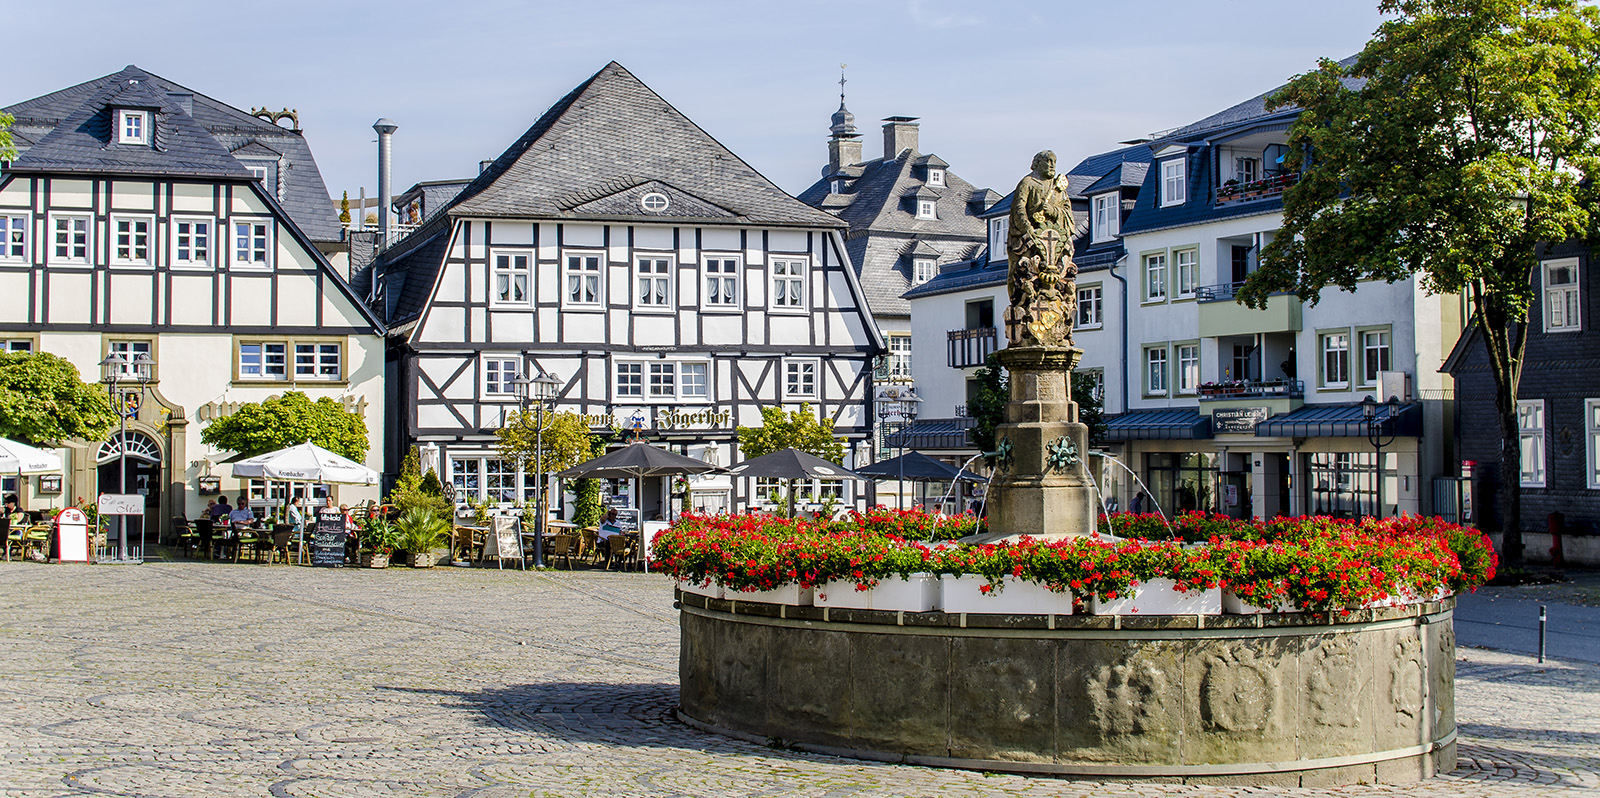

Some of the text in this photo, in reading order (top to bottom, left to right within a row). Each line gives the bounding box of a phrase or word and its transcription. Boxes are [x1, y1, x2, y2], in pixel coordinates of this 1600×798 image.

[658, 409, 730, 429] Jägerhof
[190, 460, 199, 468] 10
[278, 469, 304, 478] Krombacher
